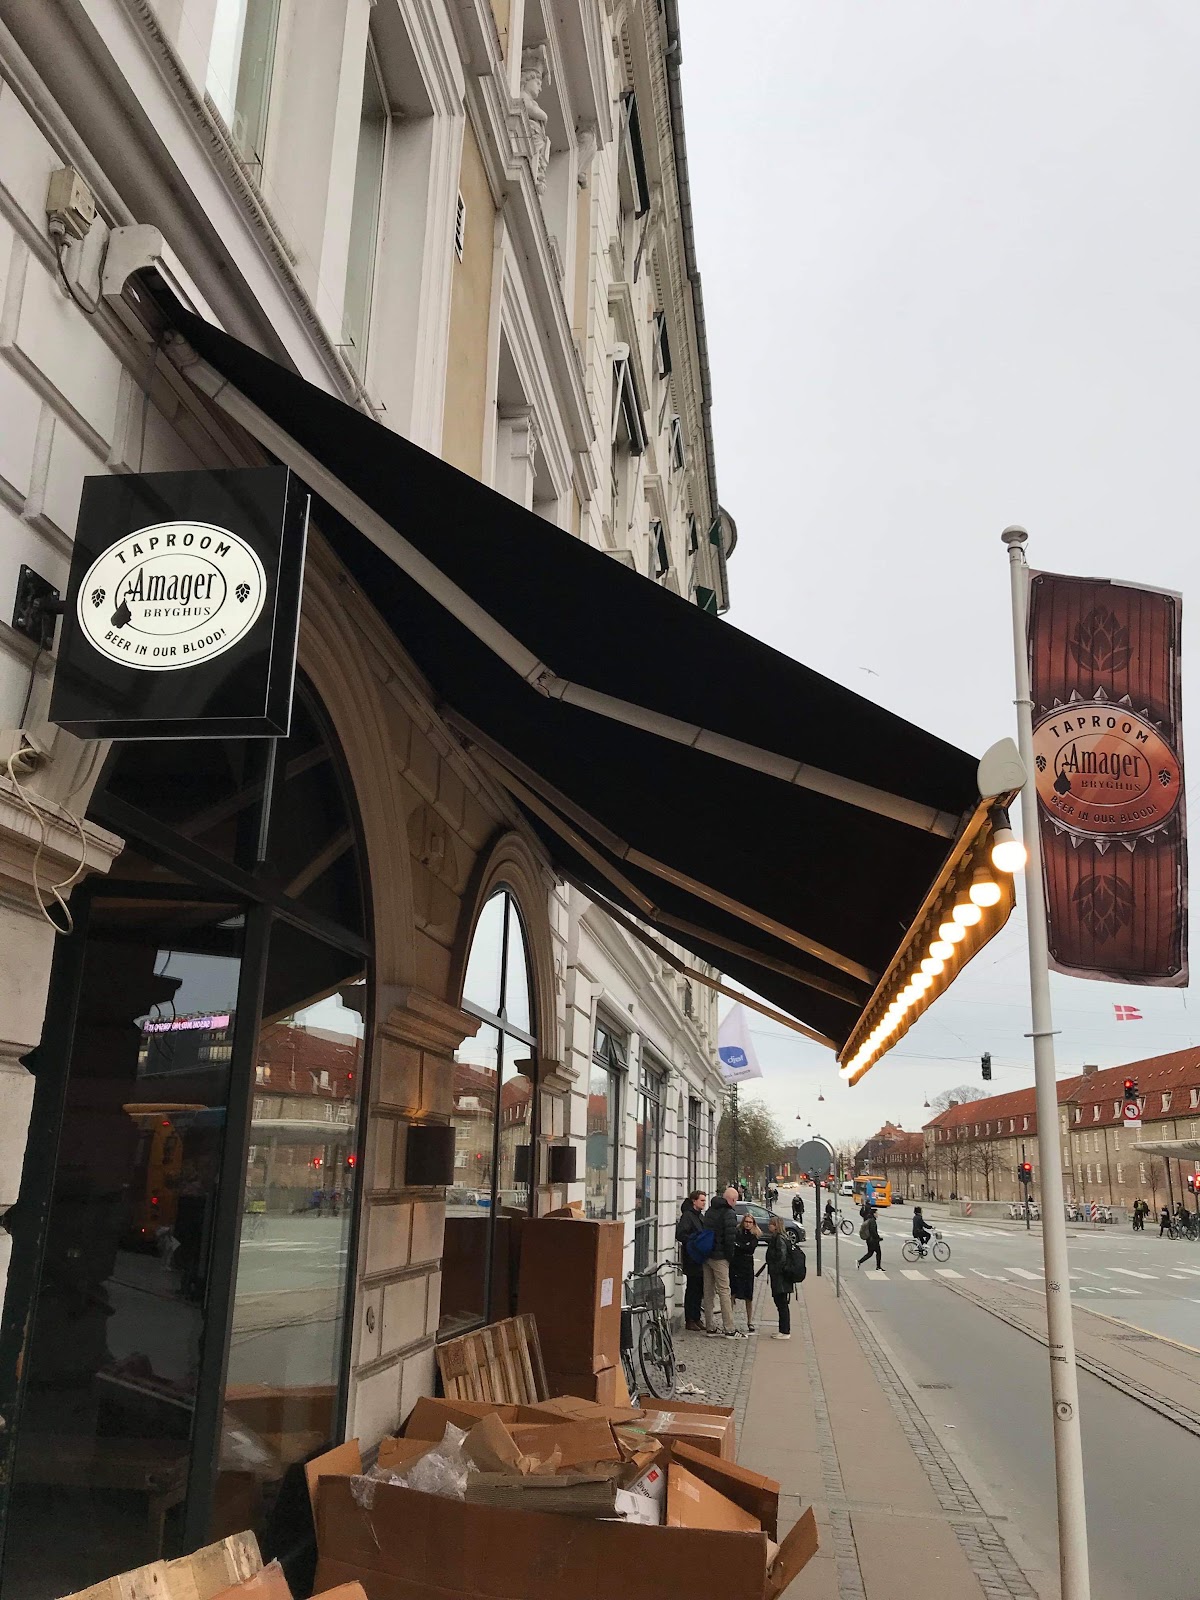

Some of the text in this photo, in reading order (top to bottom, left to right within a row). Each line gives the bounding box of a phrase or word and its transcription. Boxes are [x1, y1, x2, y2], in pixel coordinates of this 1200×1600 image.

[115, 533, 231, 564] TAPROOM
[129, 567, 217, 605] Amager
[144, 607, 211, 618] BRYGHUS
[104, 628, 227, 656] BEER IN OUR BLOOD!
[1049, 715, 1149, 744] TAPROOM
[1067, 743, 1142, 780] Amager
[1081, 780, 1141, 792] BRYGHUS
[1050, 795, 1158, 824] BEER IN OUR BLOOD!
